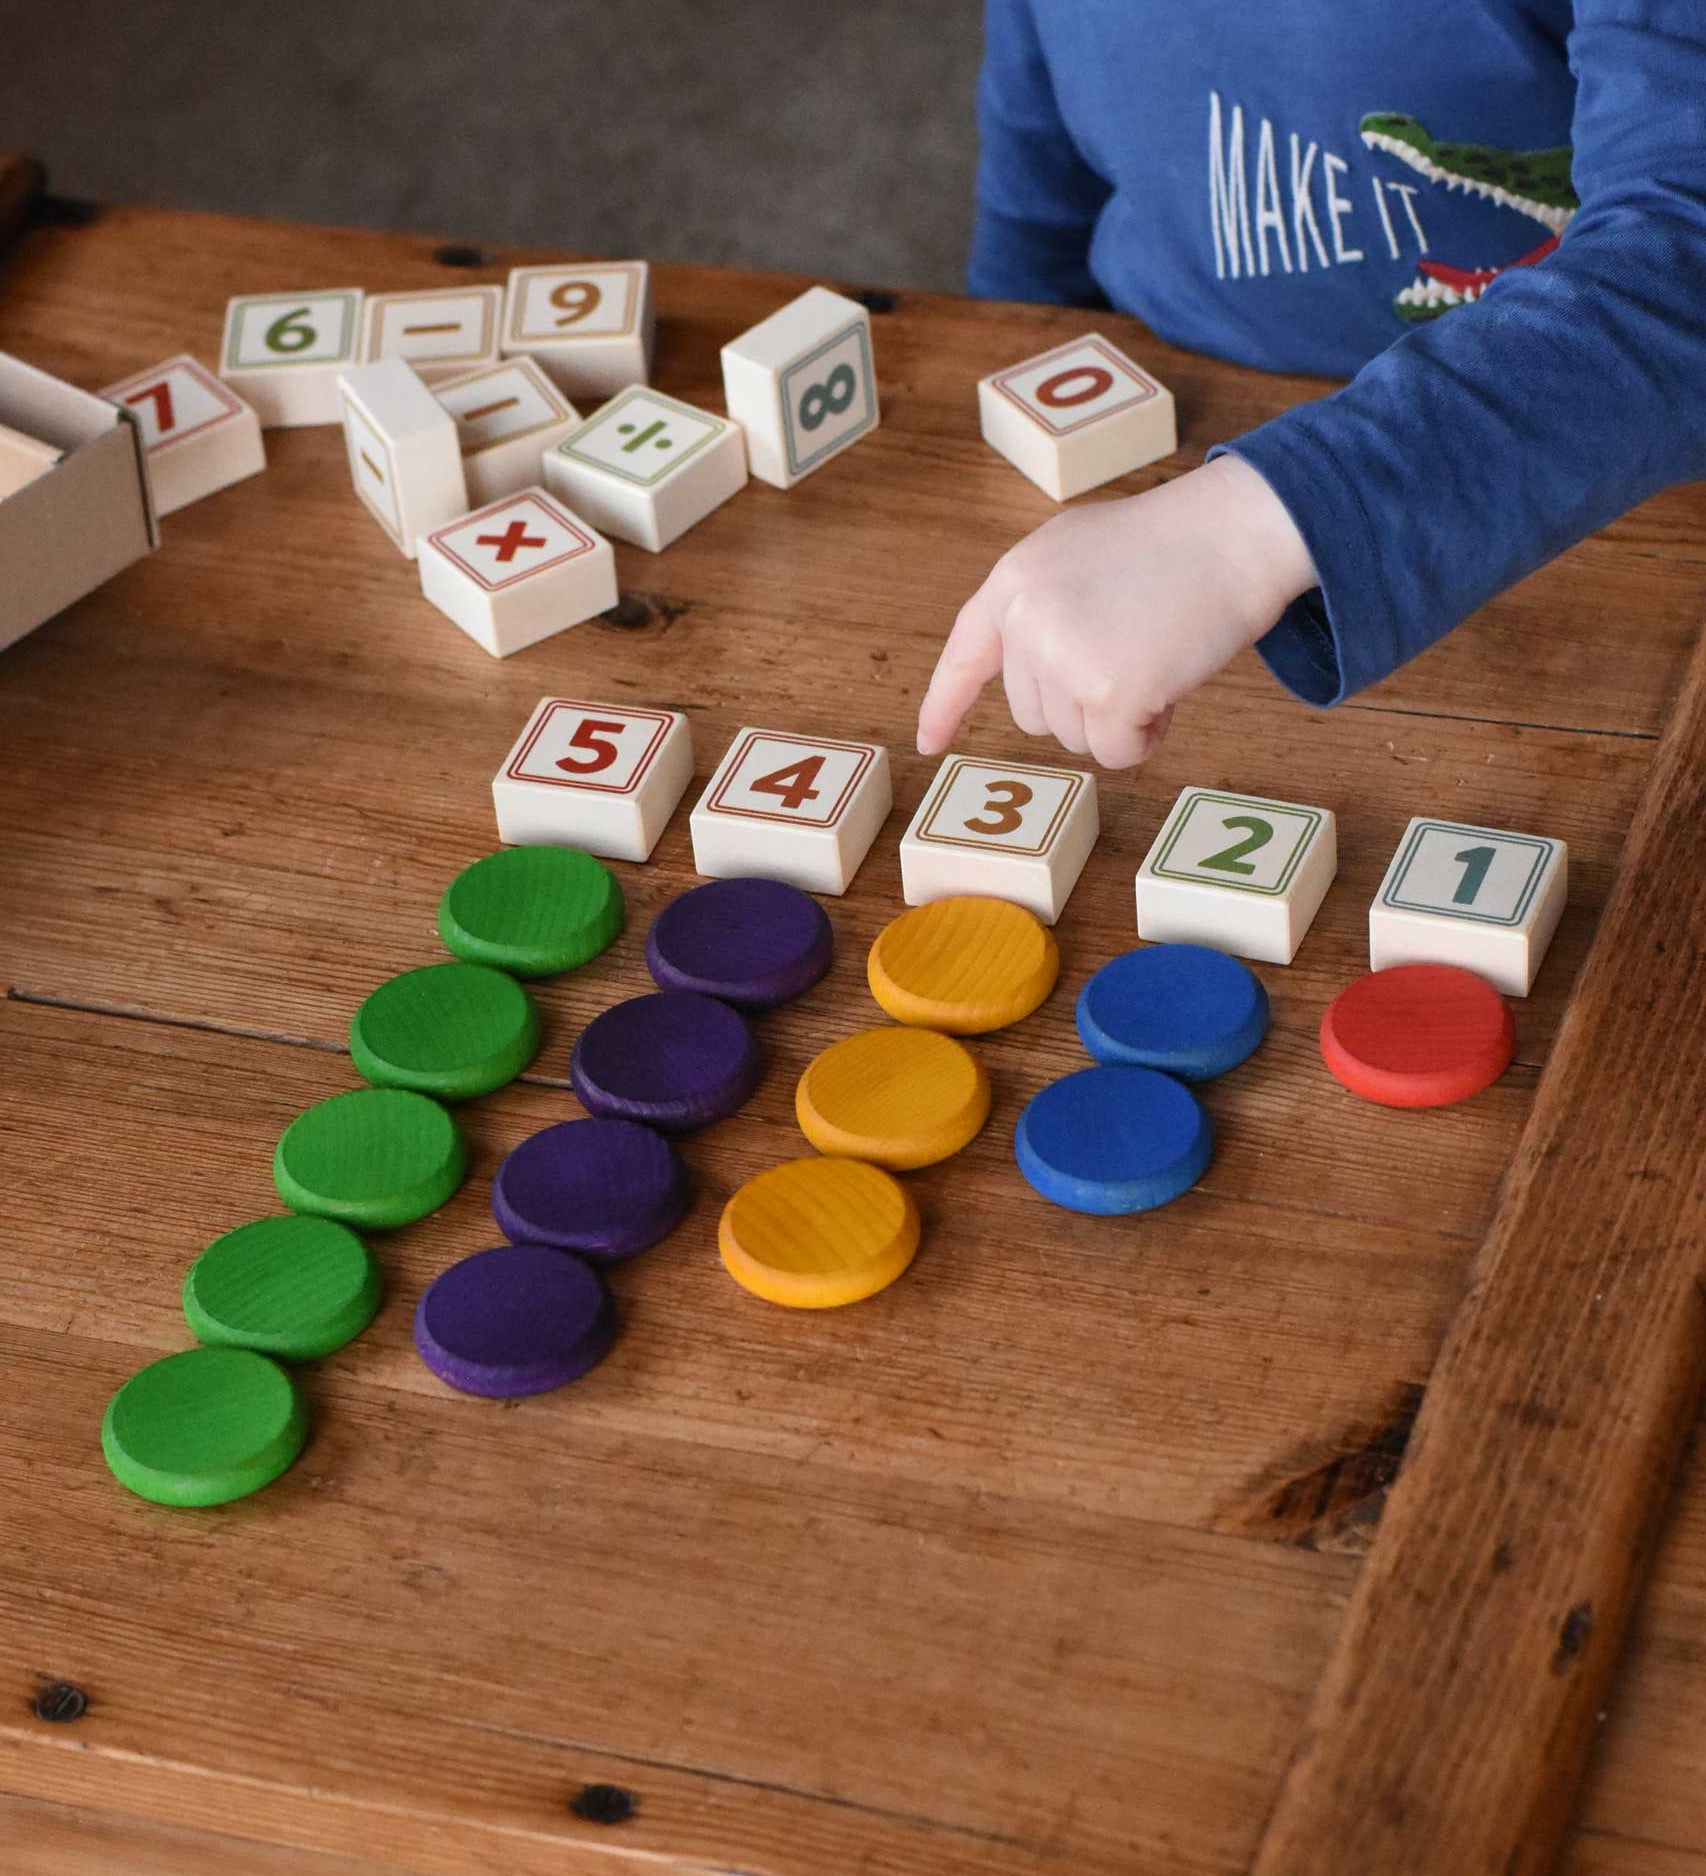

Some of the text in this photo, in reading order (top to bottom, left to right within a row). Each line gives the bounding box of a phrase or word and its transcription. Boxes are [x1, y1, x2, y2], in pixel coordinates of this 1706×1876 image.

[1209, 91, 1428, 279] MAKE IT
[264, 307, 317, 354] 6
[549, 281, 601, 327] 9
[124, 382, 175, 433] 7
[799, 362, 855, 432] 8
[1035, 366, 1114, 408] 0
[555, 718, 625, 774] 5
[749, 755, 826, 809] 4
[963, 780, 1033, 835] 3
[1197, 816, 1273, 876] 2
[1453, 846, 1497, 905] 1
